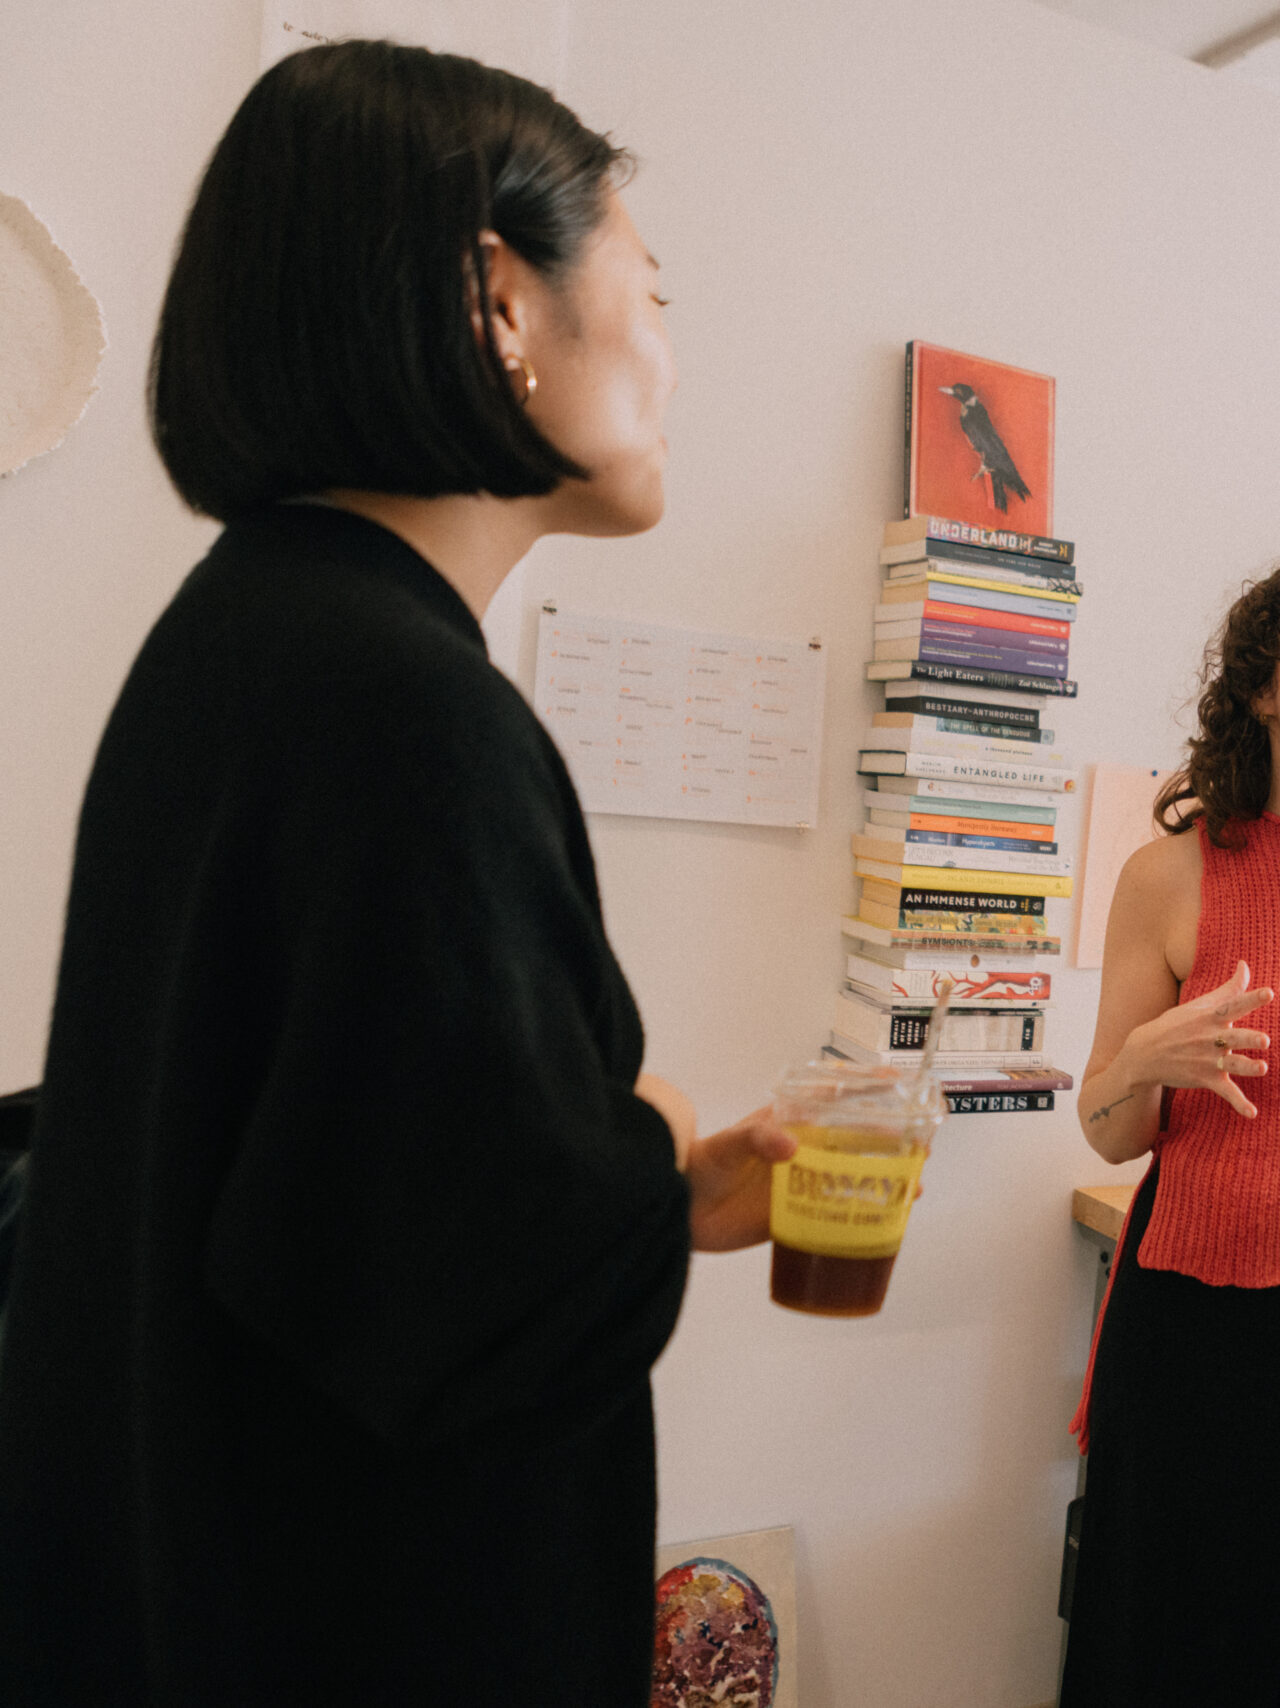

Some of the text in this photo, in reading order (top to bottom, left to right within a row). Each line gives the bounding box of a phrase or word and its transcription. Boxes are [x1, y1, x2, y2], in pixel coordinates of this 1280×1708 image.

[929, 520, 1018, 549] UNDERLAND
[928, 665, 953, 679] Light
[956, 668, 984, 682] Eaters
[953, 766, 1045, 783] ENTANGLED LIFE
[905, 894, 922, 904] AN
[925, 895, 975, 907] IMMENSE
[978, 897, 1017, 909] WORLD
[947, 1095, 1028, 1112] YSTERS
